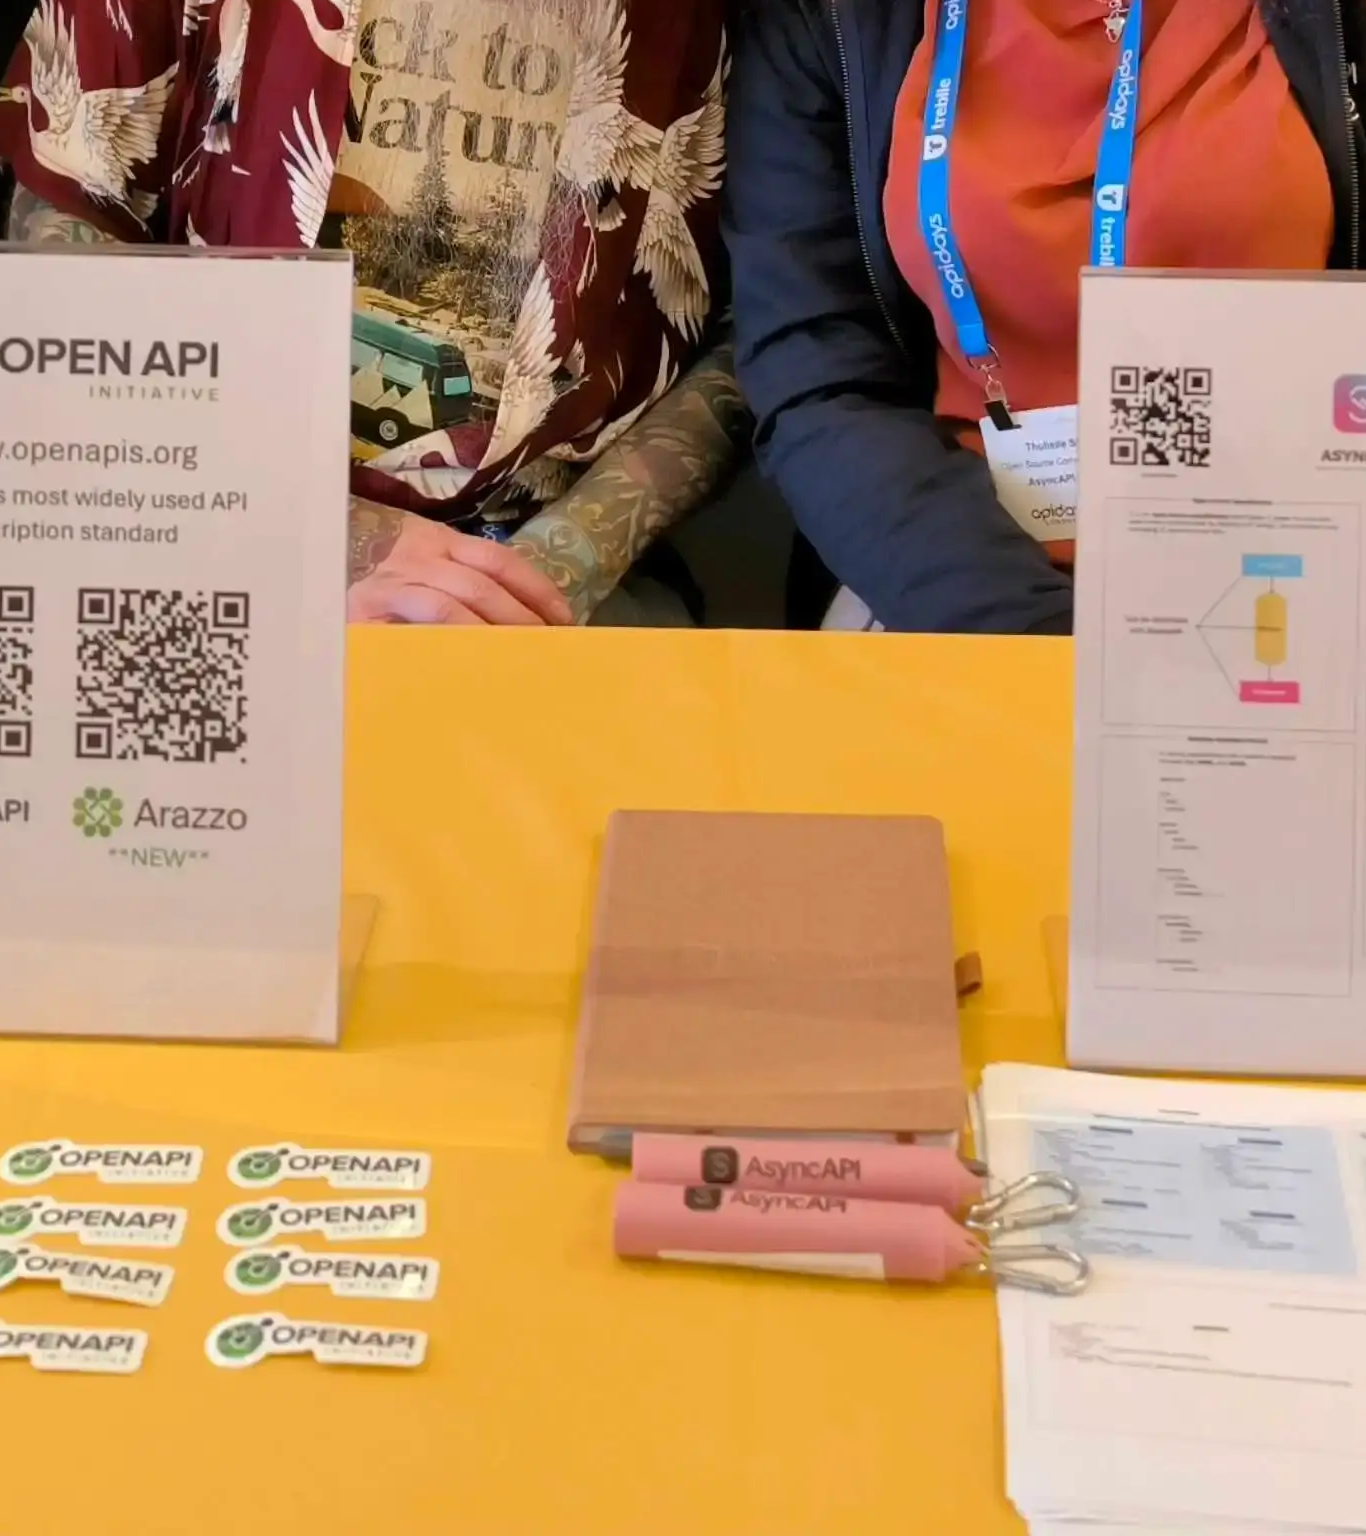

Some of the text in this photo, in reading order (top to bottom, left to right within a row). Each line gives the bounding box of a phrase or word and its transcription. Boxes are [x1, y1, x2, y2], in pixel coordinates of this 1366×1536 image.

[357, 0, 563, 96] ck to
[1110, 48, 1134, 132] apidays
[933, 78, 951, 132] treblle
[1098, 216, 1116, 268] trebll
[929, 213, 965, 299] apidays
[142, 338, 220, 380] API
[89, 385, 220, 402] INITIATIVE
[12, 486, 67, 507] most
[75, 487, 146, 511] widely
[151, 489, 206, 511] used
[211, 491, 248, 511] API
[1031, 505, 1076, 521] apida
[81, 522, 179, 544] standard
[133, 798, 249, 831] Arazzo
[59, 1150, 193, 1168] OPENAPI
[288, 1154, 421, 1174] OPENAPI
[746, 1156, 861, 1182] AsyncAPI
[39, 1209, 177, 1230] OPENAPI
[279, 1204, 417, 1225] OPENAPI
[24, 1255, 163, 1287] OPENAPI
[288, 1258, 429, 1282] OPENAPI
[271, 1326, 417, 1349] OPENAPI
